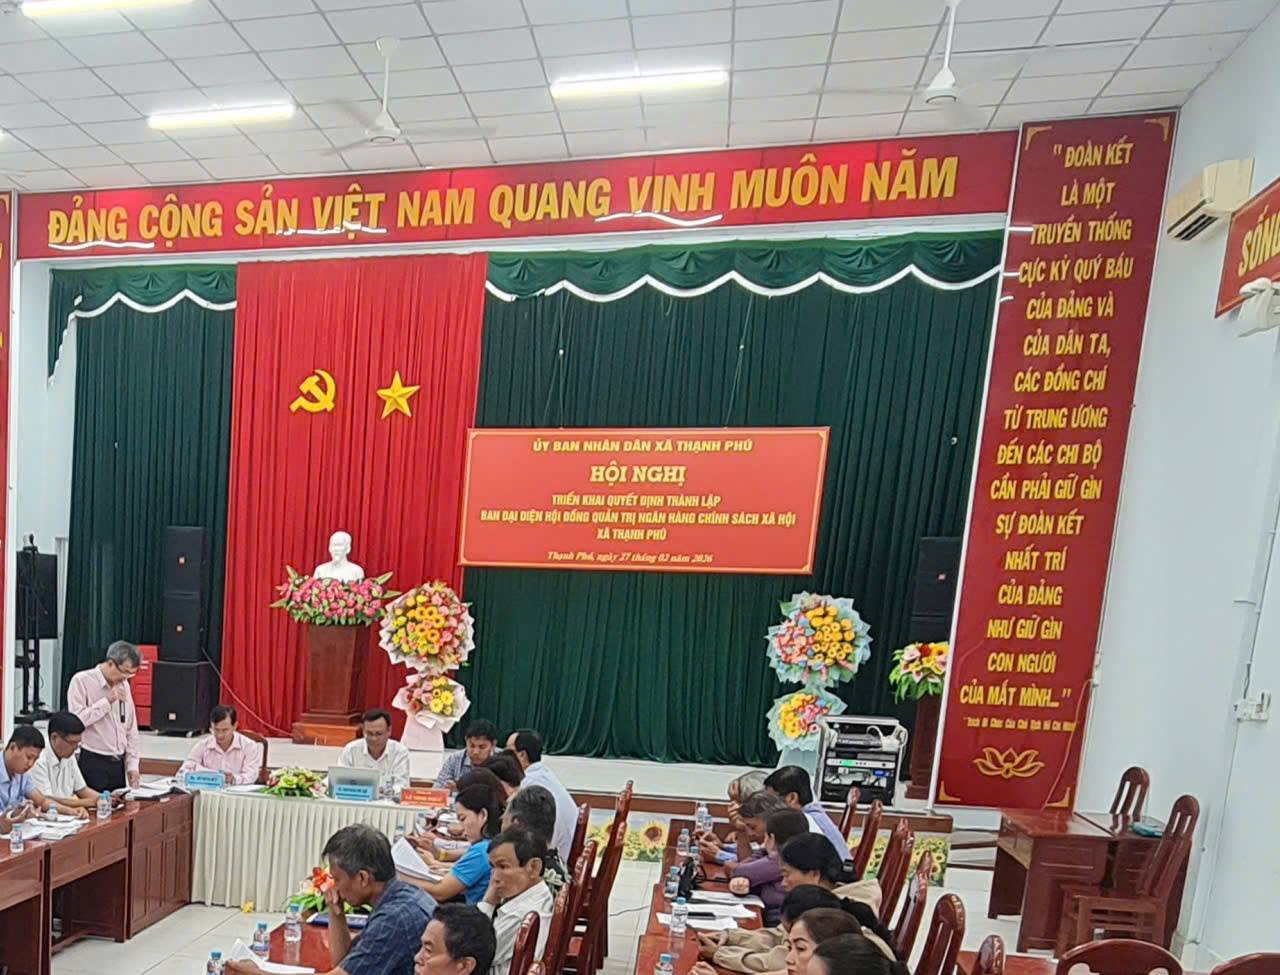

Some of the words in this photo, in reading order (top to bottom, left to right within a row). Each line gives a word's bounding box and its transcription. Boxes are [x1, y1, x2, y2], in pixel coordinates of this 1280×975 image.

[1065, 140, 1104, 168] ĐOÀN
[1105, 135, 1136, 166] KẾT
[48, 194, 127, 243] ĐẢNG
[139, 193, 223, 247] CỘNG
[235, 184, 298, 235] SẢN
[313, 184, 386, 240] VIỆT
[397, 188, 476, 227] NAM
[489, 178, 611, 229] QUANG
[628, 172, 715, 214] VINH
[730, 153, 848, 209] MUÔN
[861, 148, 959, 202] NĂM
[1060, 179, 1079, 206] LÀ
[1082, 177, 1116, 209] MỘT
[1088, 211, 1134, 241] THỐNG
[1019, 256, 1047, 289] CỰC
[1073, 253, 1103, 284] QUÝ
[1105, 252, 1135, 279] BÁU
[1026, 291, 1053, 320] CỦA
[1057, 290, 1094, 319] ĐẢNG
[1097, 291, 1115, 318] VÀ
[1023, 328, 1050, 356] CỦA
[1055, 329, 1084, 356] DÂN
[1089, 333, 1112, 358] TA,
[1014, 366, 1041, 392] CÁC
[1083, 365, 1108, 391] CHÍ
[1003, 404, 1024, 430] TỪ
[1025, 407, 1068, 430] TRUNG
[1071, 403, 1109, 429] ƯƠNG
[552, 440, 580, 452] BAN
[583, 438, 620, 452] NHÂN
[623, 438, 652, 452] DÂN
[654, 439, 673, 452] XÃ
[677, 440, 721, 454] THẠNH
[724, 438, 753, 452] PHÚ
[997, 437, 1024, 465] ĐẾN
[1026, 439, 1054, 465] CÁC
[1056, 443, 1081, 466] CHI
[1082, 439, 1103, 470] BỘ
[589, 459, 628, 487] HỘI
[631, 464, 687, 487] NGHỊ
[1020, 471, 1052, 500] PHẢI
[1054, 473, 1079, 500] GIỮ
[1080, 474, 1103, 499] GÌN
[480, 509, 501, 521] BAN
[995, 511, 1017, 540] SỰ
[1017, 509, 1055, 535] ĐOÀN
[1056, 508, 1085, 535] KẾT
[1004, 544, 1040, 571] NHẤT
[1044, 546, 1068, 571] TRÍ
[998, 578, 1024, 605] CỦA
[1027, 578, 1064, 606] ĐẢNG
[987, 616, 1016, 640] NHƯ
[1016, 615, 1040, 640] GIỮ
[1040, 616, 1064, 640] GÌN
[987, 652, 1015, 673] CON
[960, 679, 984, 705] CỦA
